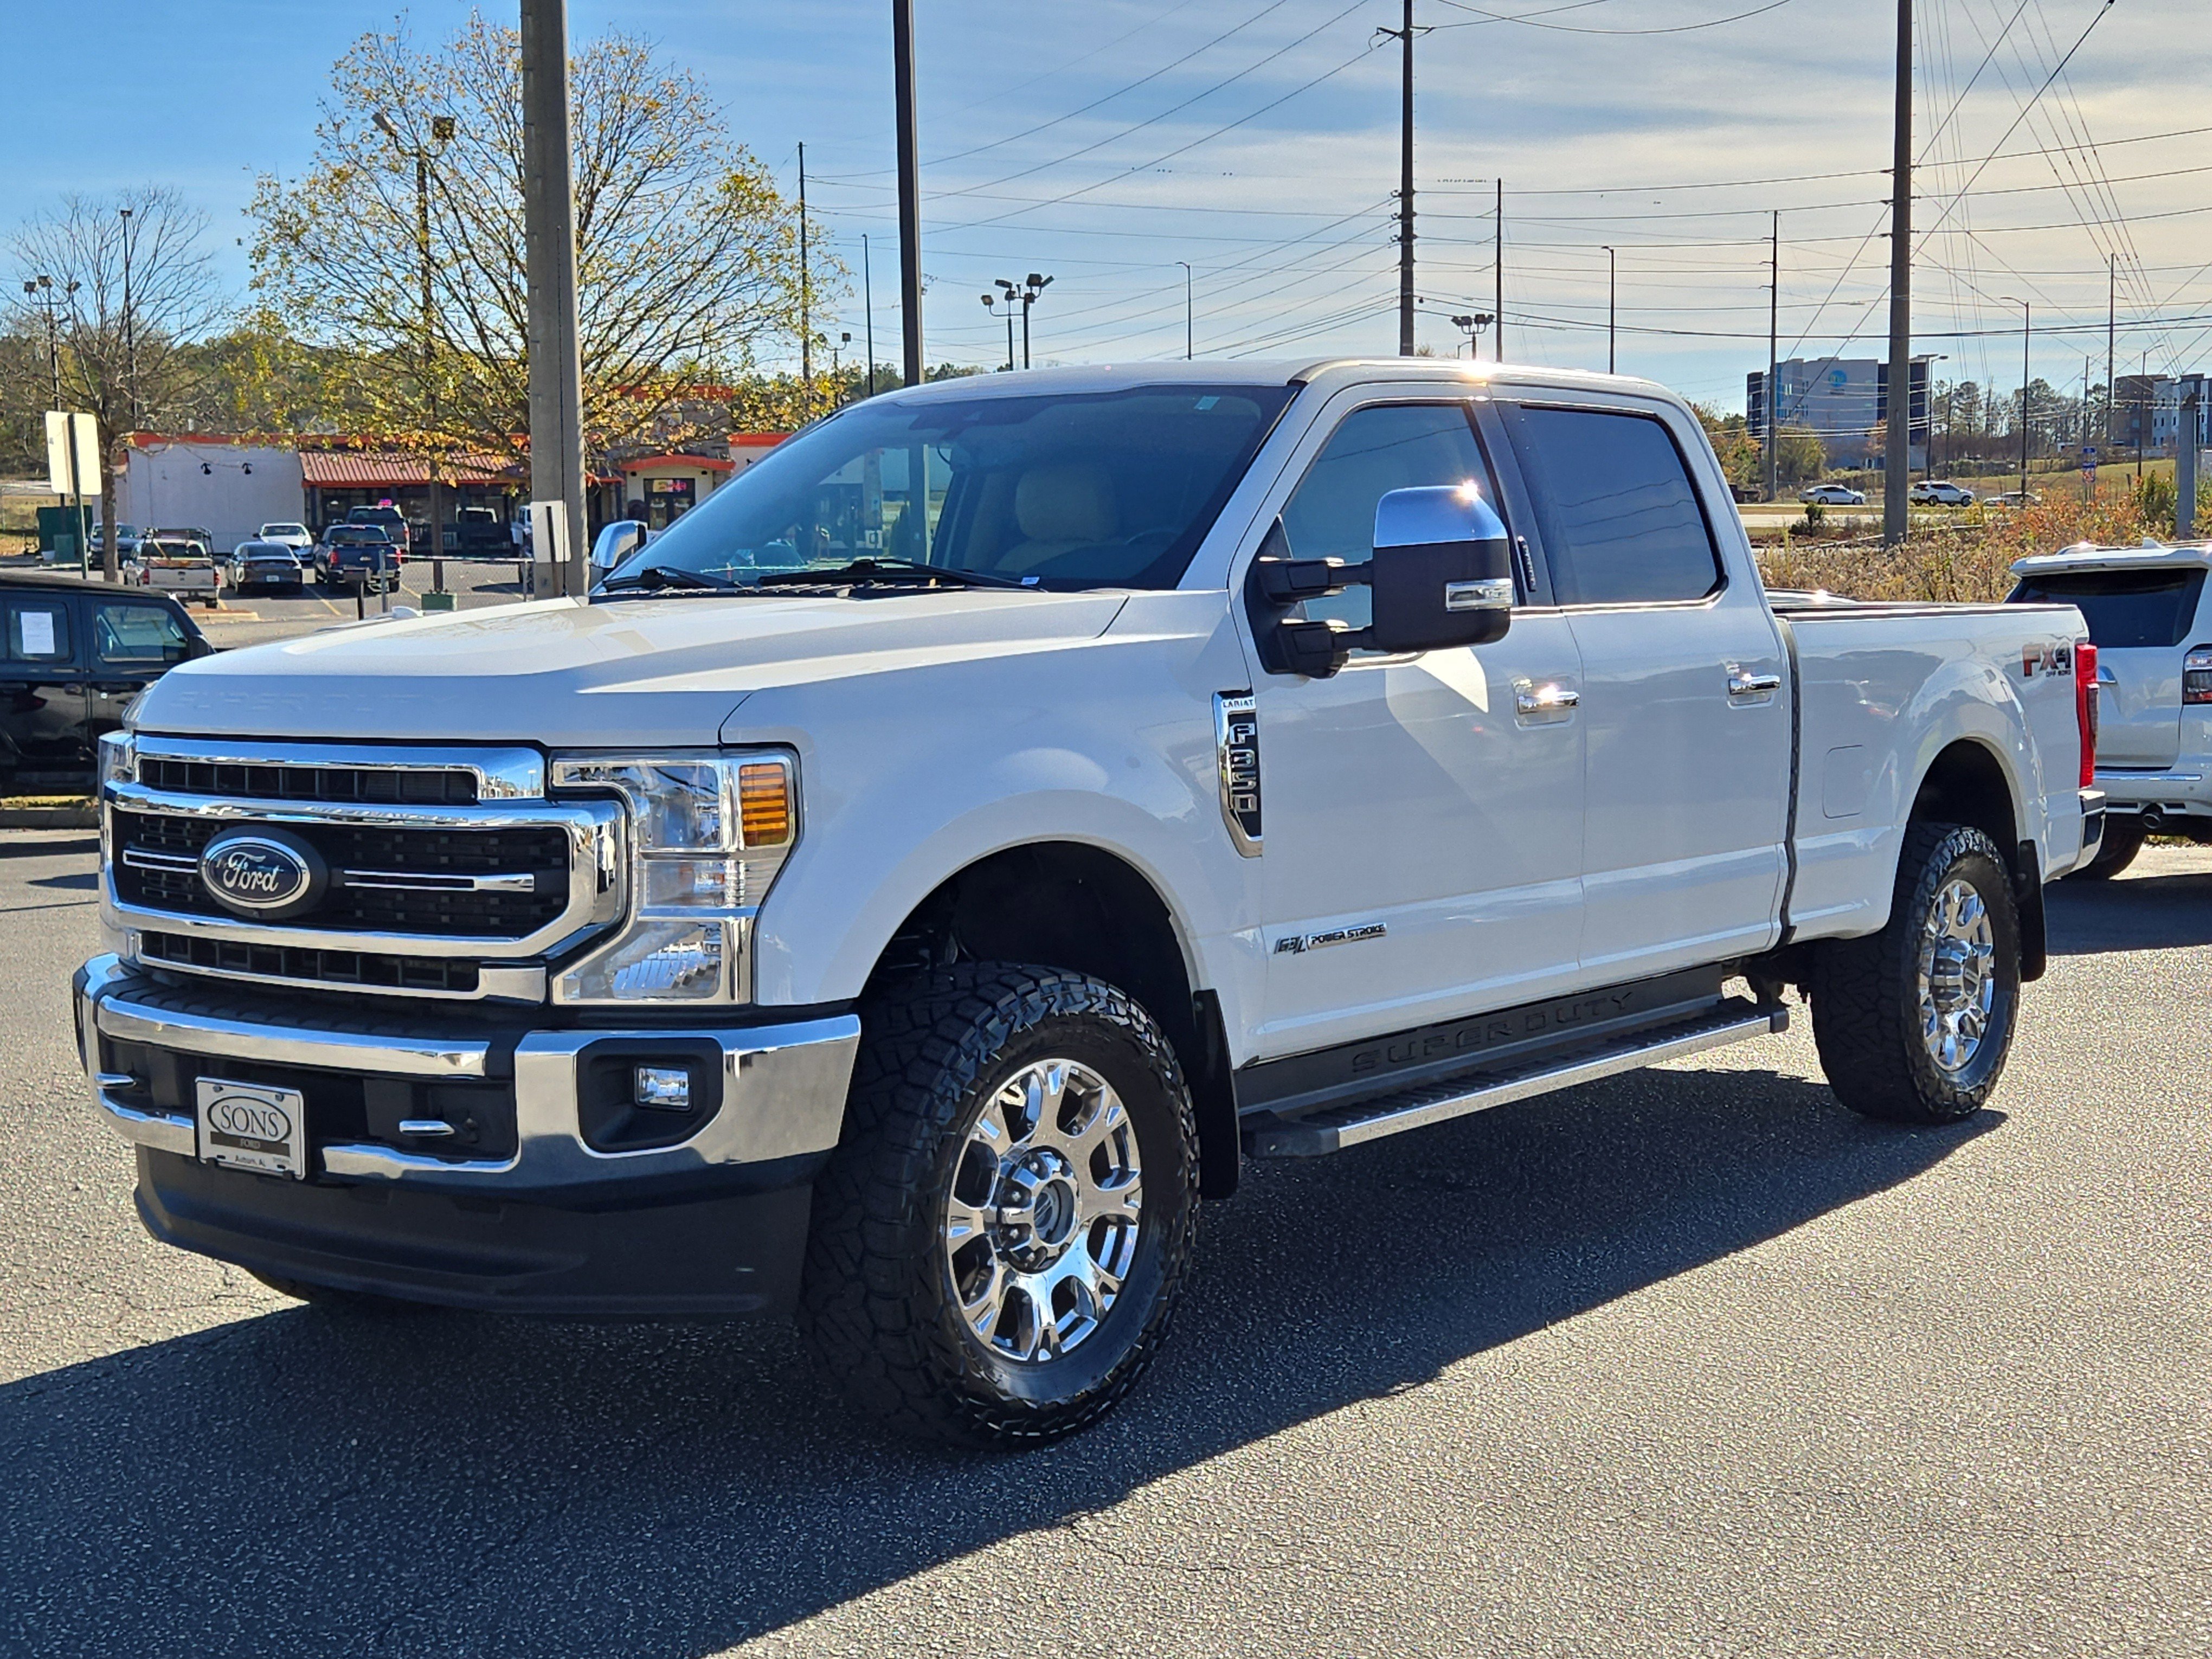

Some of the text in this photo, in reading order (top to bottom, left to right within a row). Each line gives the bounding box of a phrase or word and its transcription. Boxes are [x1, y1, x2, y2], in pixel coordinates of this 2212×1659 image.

[2022, 642, 2071, 677] FX4
[1223, 699, 1253, 708] LARIAT
[223, 852, 280, 892] Ford
[1311, 930, 1345, 945] POWER
[1347, 923, 1386, 938] STROKE
[1352, 992, 1634, 1073] SUPER DUTY
[220, 1105, 279, 1137] SONS
